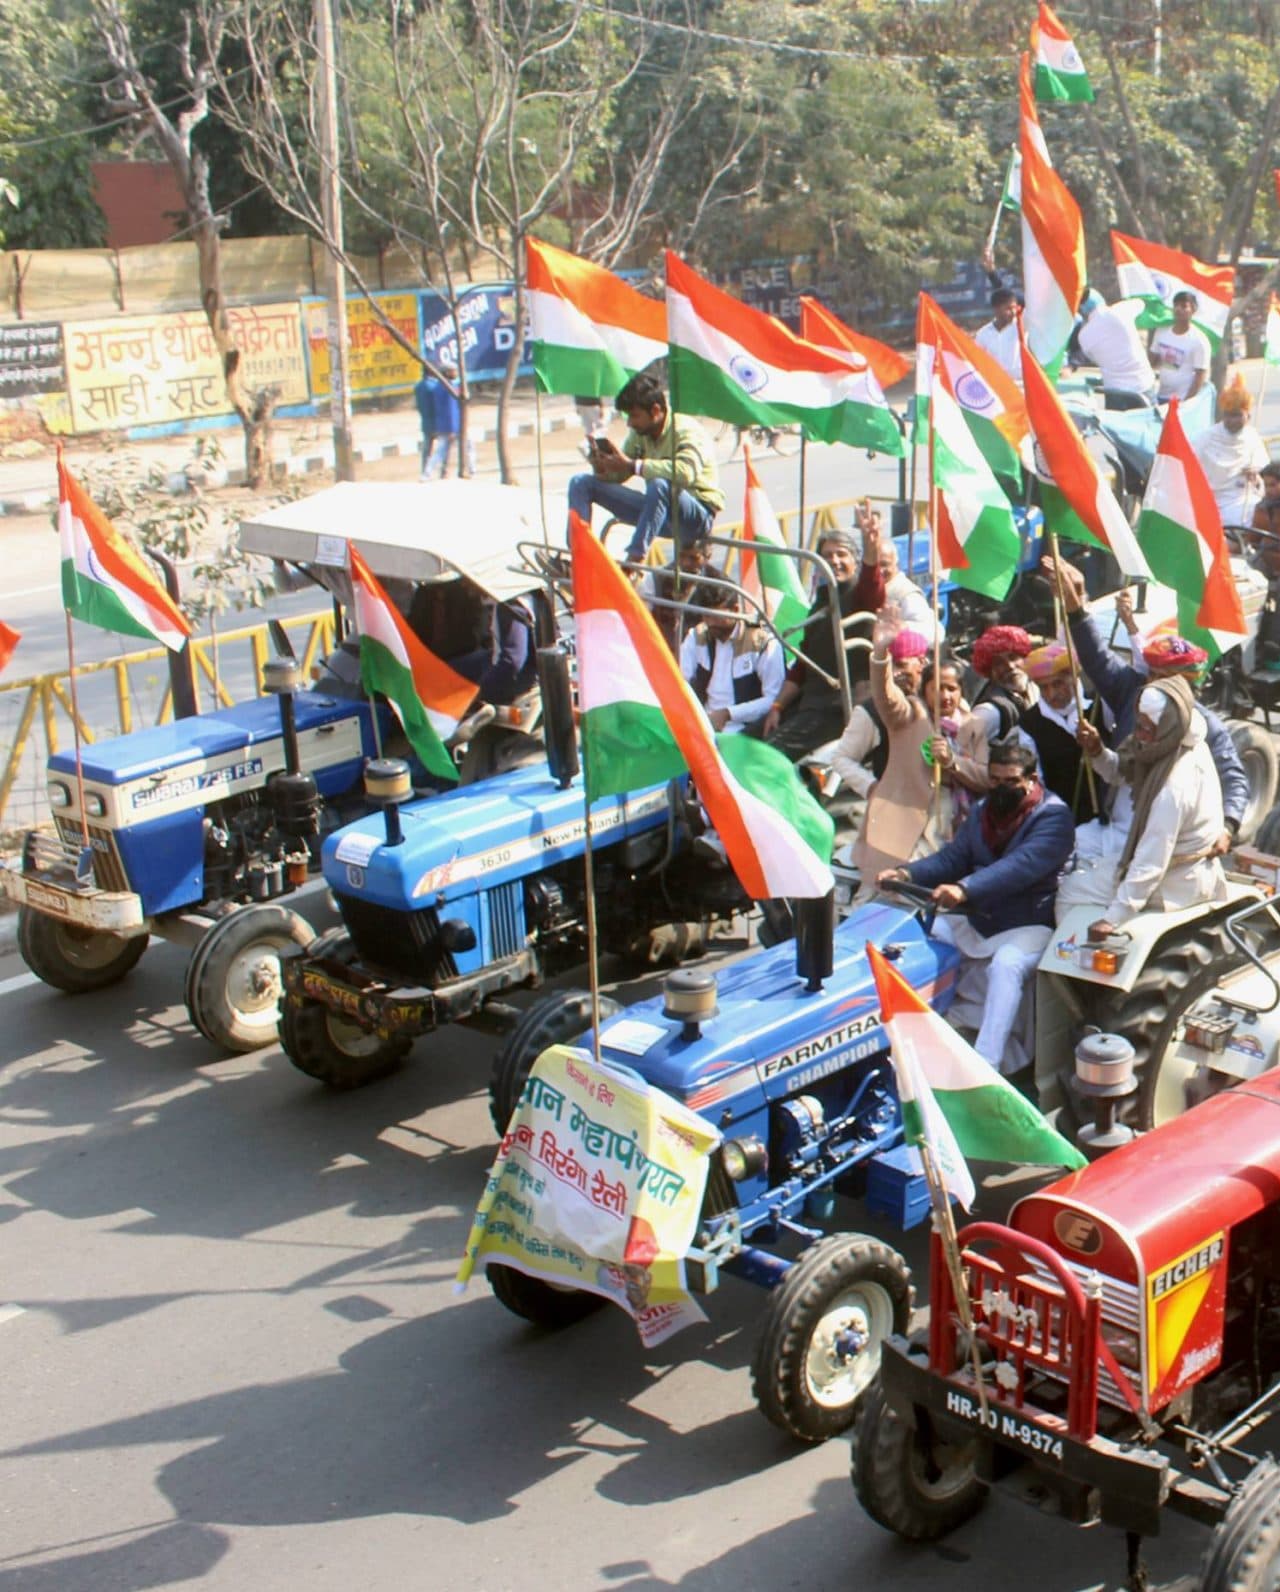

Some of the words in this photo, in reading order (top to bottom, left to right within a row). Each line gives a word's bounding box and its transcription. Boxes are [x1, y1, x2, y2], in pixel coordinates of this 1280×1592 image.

[479, 850, 512, 872] 3630
[542, 831, 571, 848] New
[763, 1015, 882, 1077] FARMTRA
[787, 1037, 880, 1091] CHAMPION
[539, 1130, 589, 1192] तिरंगा
[592, 1170, 628, 1215] रैली
[1153, 1239, 1224, 1299] EICHER
[1002, 1415, 1064, 1460] N-9374
